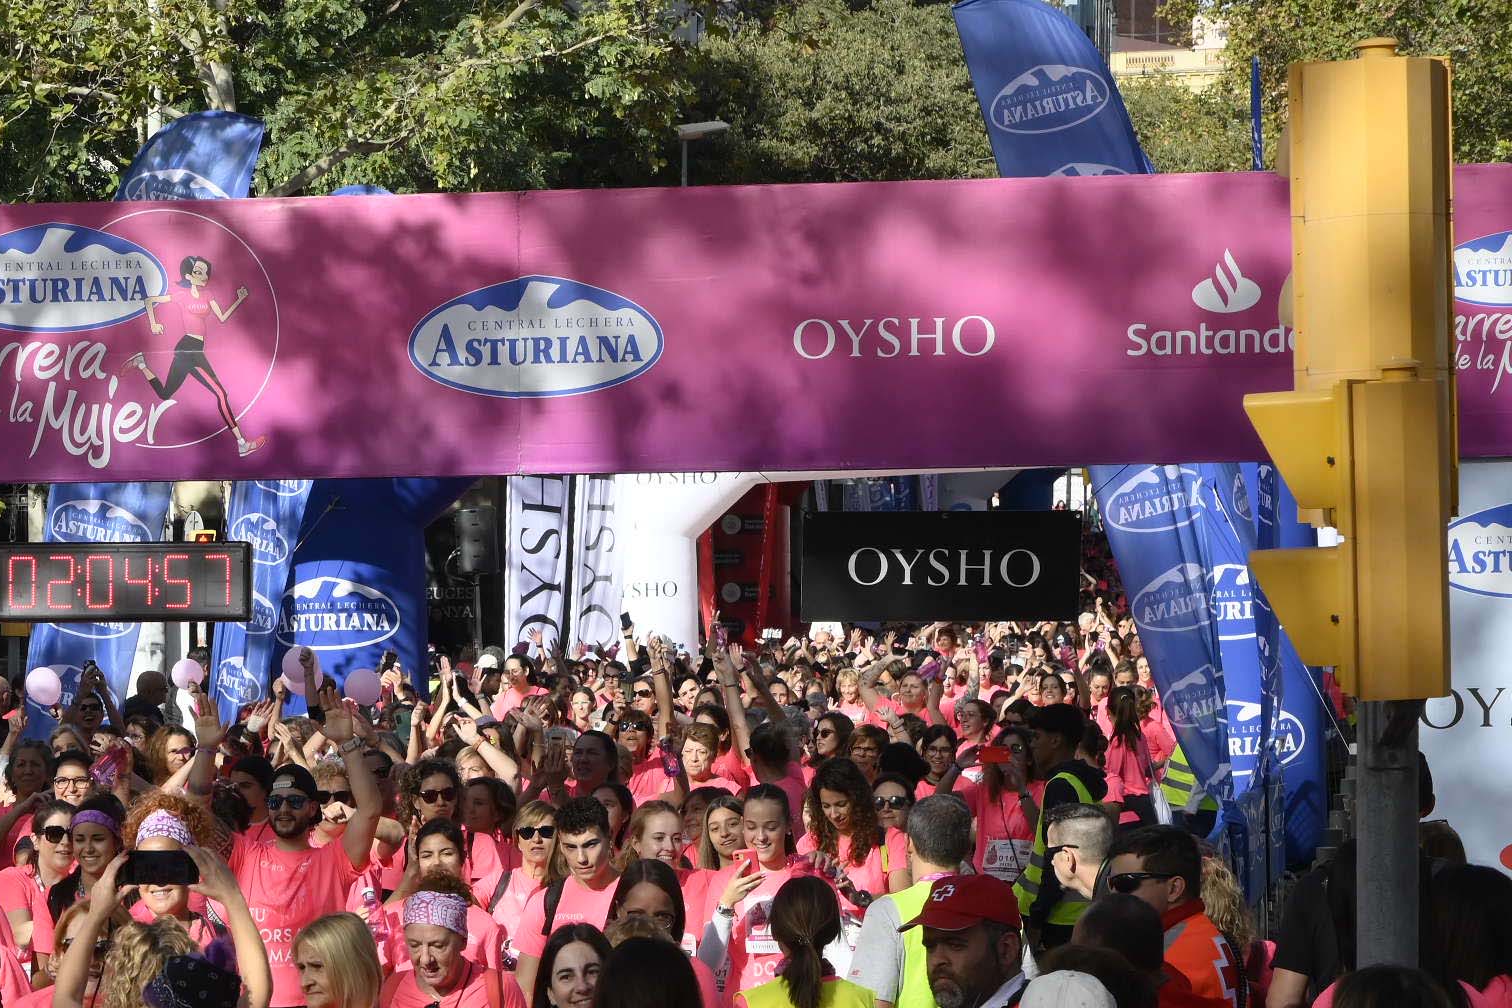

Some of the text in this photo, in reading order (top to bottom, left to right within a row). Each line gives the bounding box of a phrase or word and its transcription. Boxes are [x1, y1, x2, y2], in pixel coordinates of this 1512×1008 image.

[71, 259, 143, 271] LECHERA
[428, 322, 644, 367] ASTURIANA
[467, 317, 635, 331] CENTRAL LECHERA
[792, 315, 996, 360] OYSHO
[9, 382, 34, 424] la
[28, 374, 177, 470] Mujer
[8, 554, 231, 608] 02:04:57
[848, 546, 1040, 588] OYSHO
[621, 580, 678, 599] YSHO
[278, 610, 391, 634] ASTURIANA
